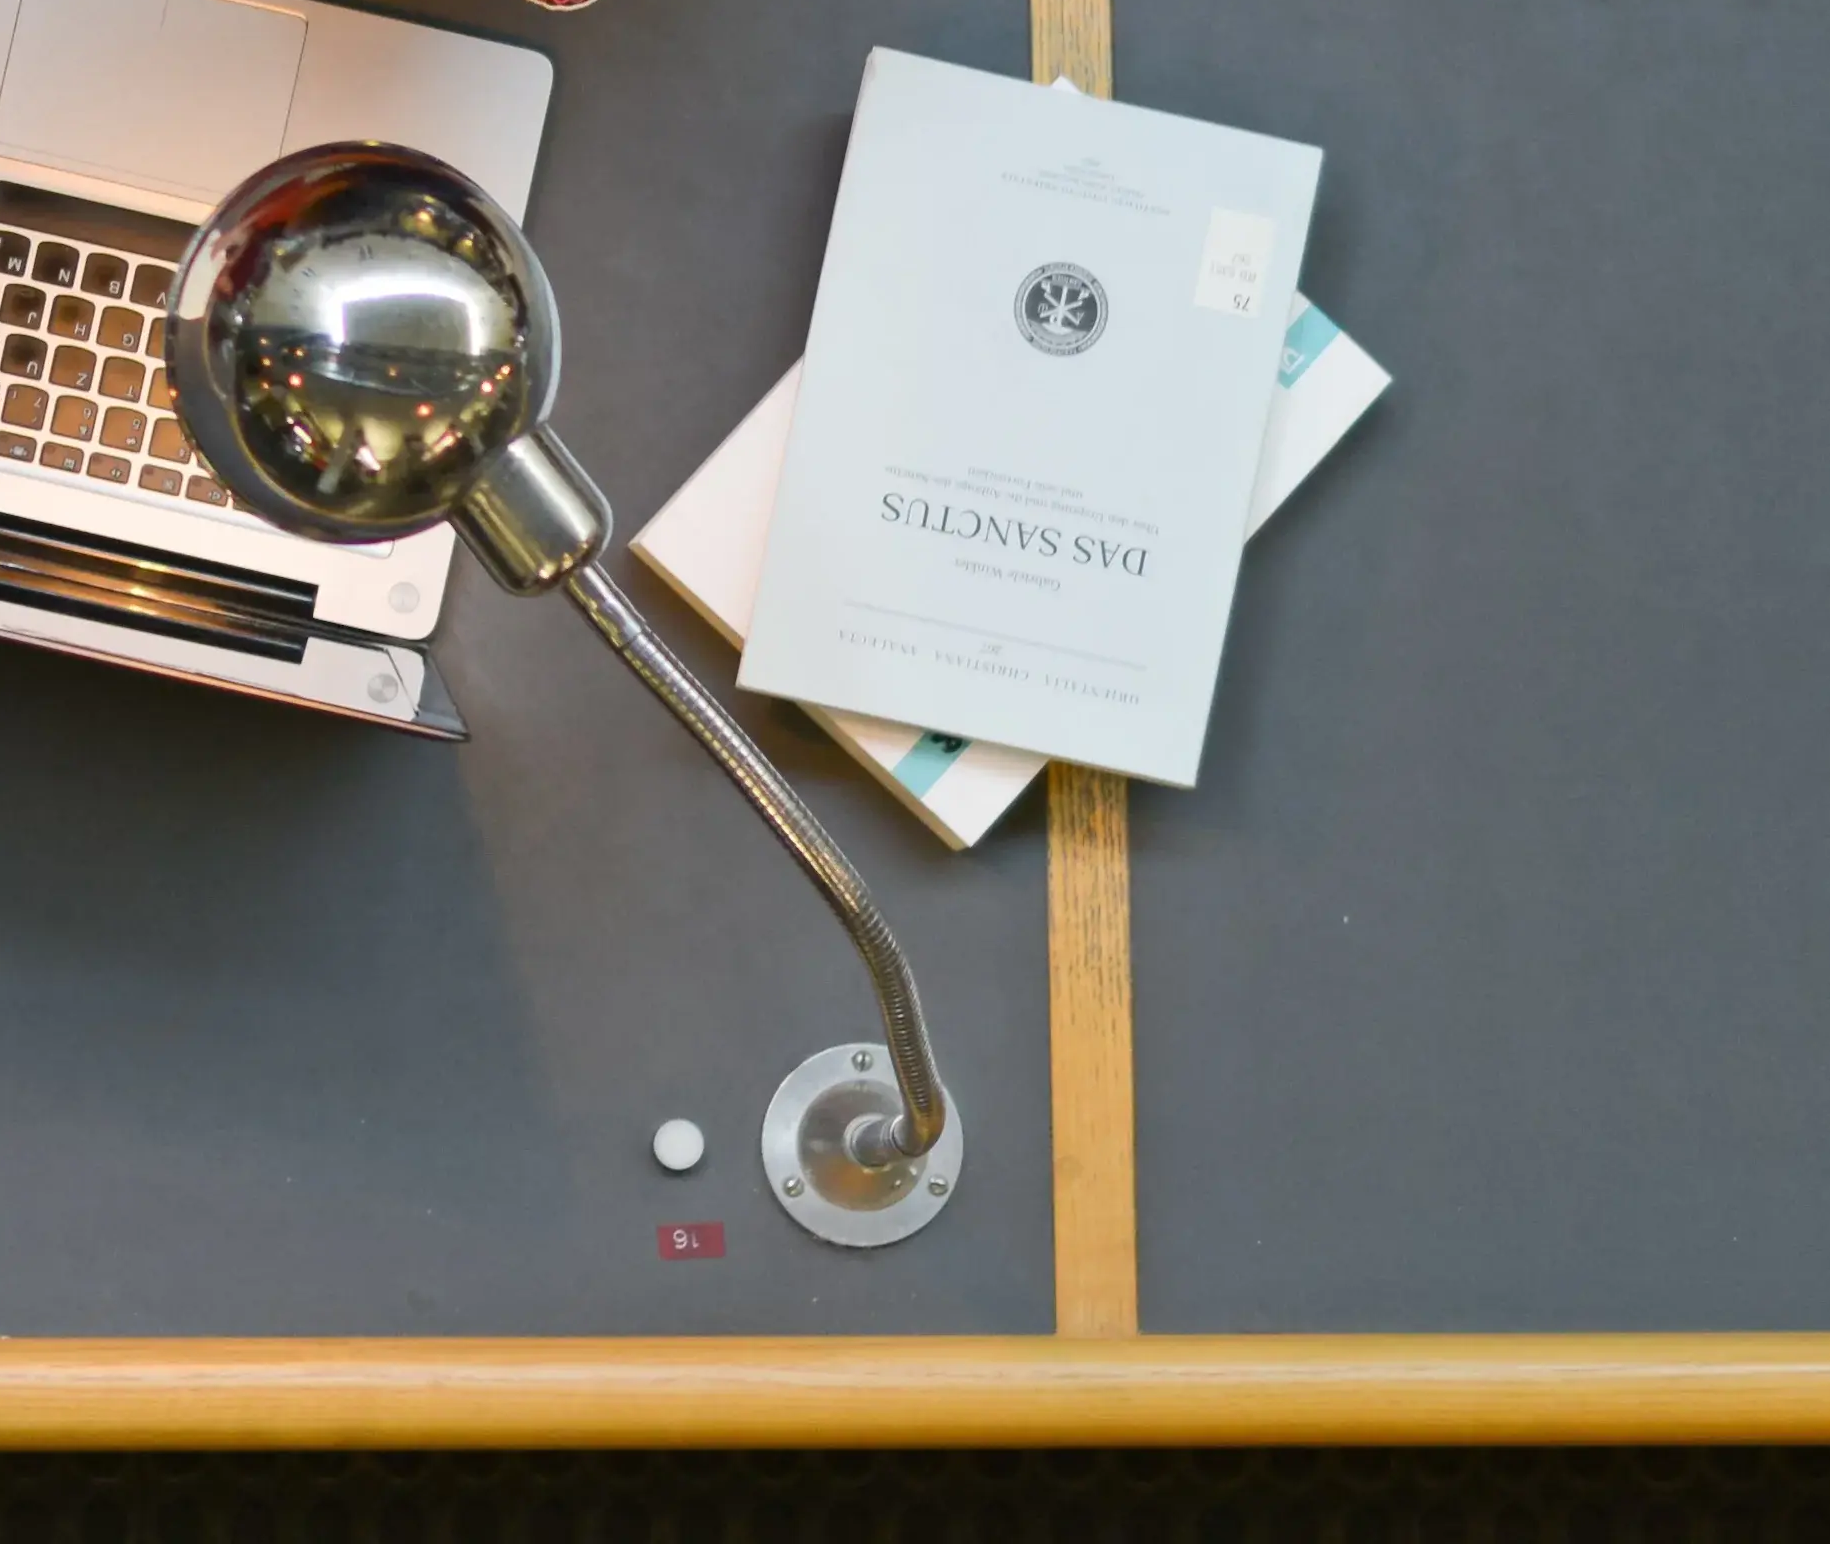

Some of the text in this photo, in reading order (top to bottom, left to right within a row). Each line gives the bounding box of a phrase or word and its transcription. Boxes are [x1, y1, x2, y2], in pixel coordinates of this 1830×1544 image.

[7, 257, 22, 271] M
[57, 268, 70, 282] N
[108, 280, 120, 294] B
[155, 291, 166, 305] V
[1232, 293, 1250, 311] 75
[26, 311, 37, 323] J
[73, 322, 86, 336] H
[121, 332, 134, 347] G
[25, 360, 38, 375] U
[75, 371, 87, 386] Z
[32, 396, 41, 407] 7
[880, 492, 1147, 576] DAS SANCTUS
[672, 1228, 700, 1251] 16
